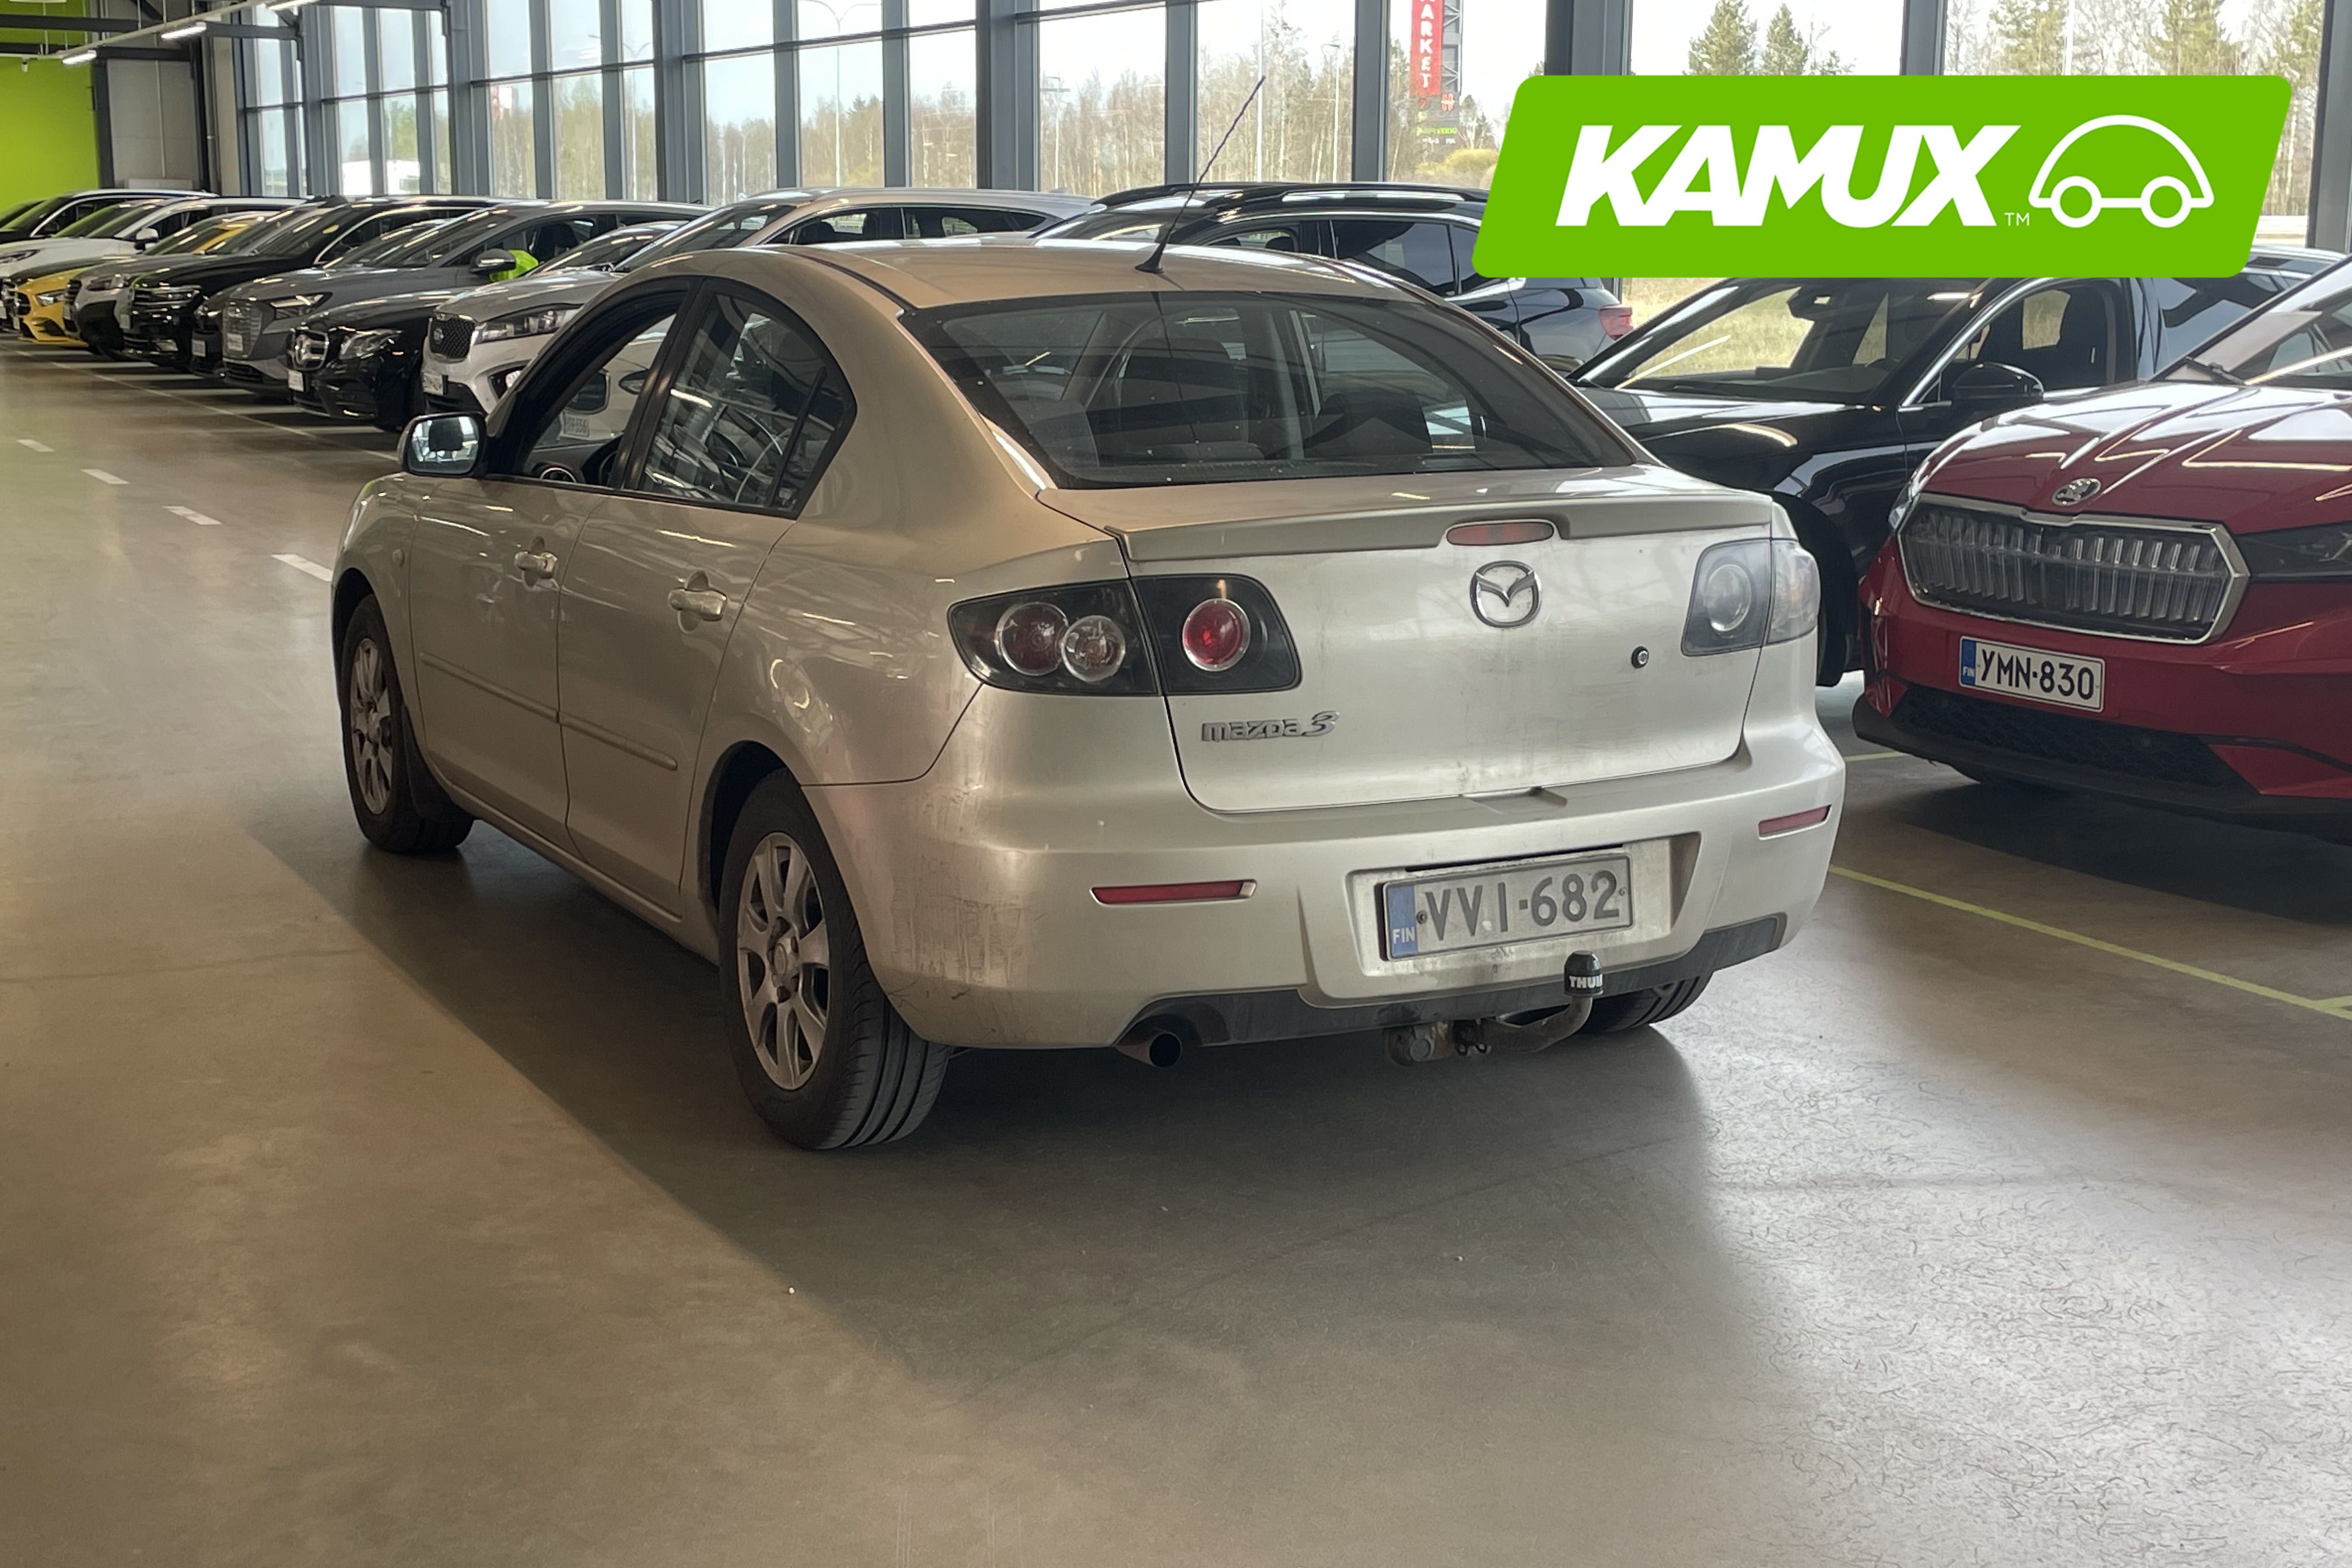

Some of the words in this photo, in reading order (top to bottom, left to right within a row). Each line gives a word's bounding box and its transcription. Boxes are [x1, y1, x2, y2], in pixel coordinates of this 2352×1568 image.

[1419, 0, 1436, 88] ARKET
[1981, 649, 2094, 699] YMN-830
[1393, 926, 1415, 944] FIN
[1424, 870, 1620, 941] VVI-682
[1569, 974, 1603, 988] THUL
